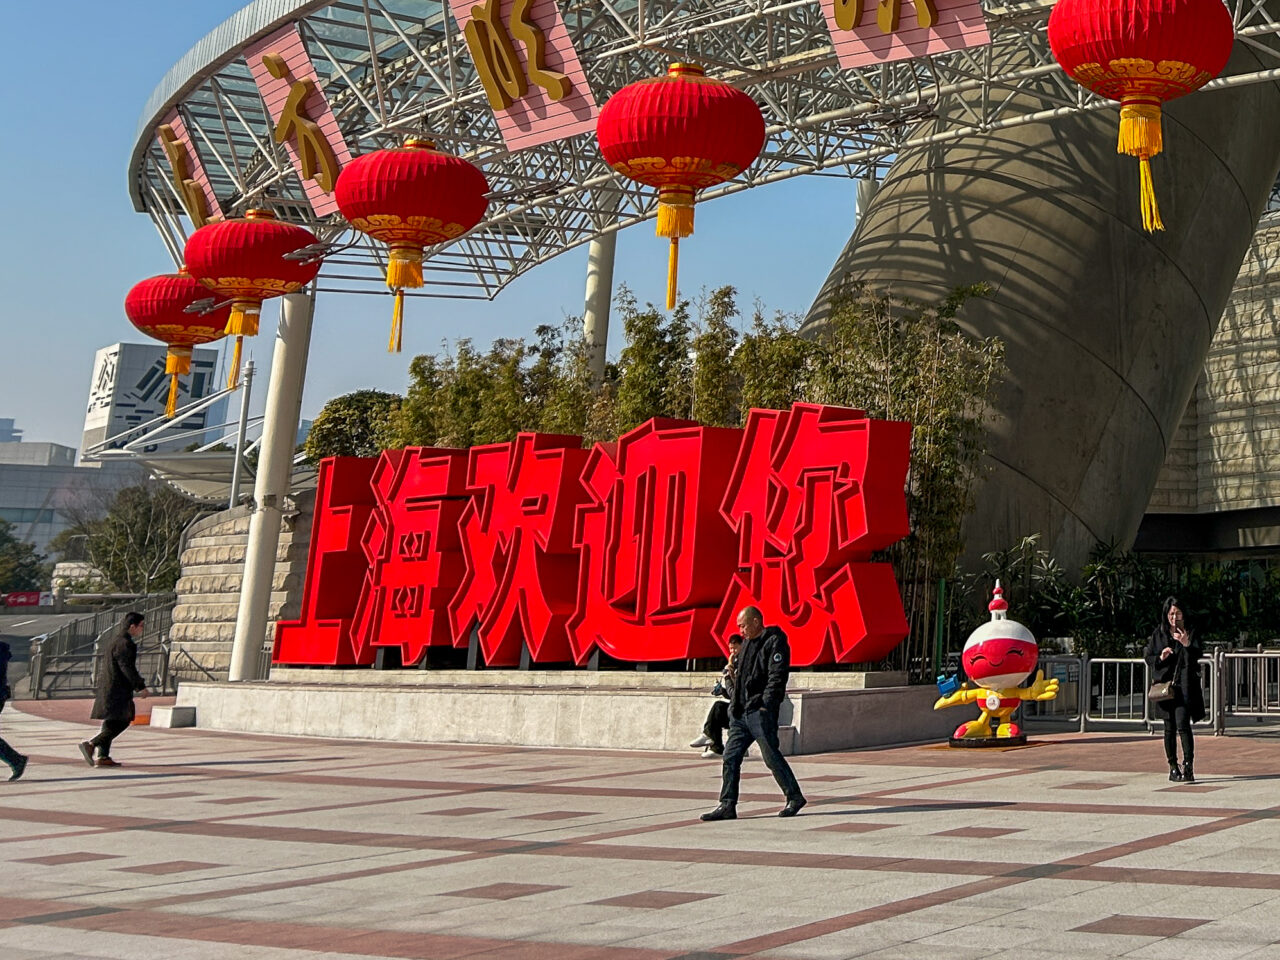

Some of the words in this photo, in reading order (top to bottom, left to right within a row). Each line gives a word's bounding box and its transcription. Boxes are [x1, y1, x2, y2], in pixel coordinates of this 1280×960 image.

[271, 401, 911, 667] 上海欢迎您
